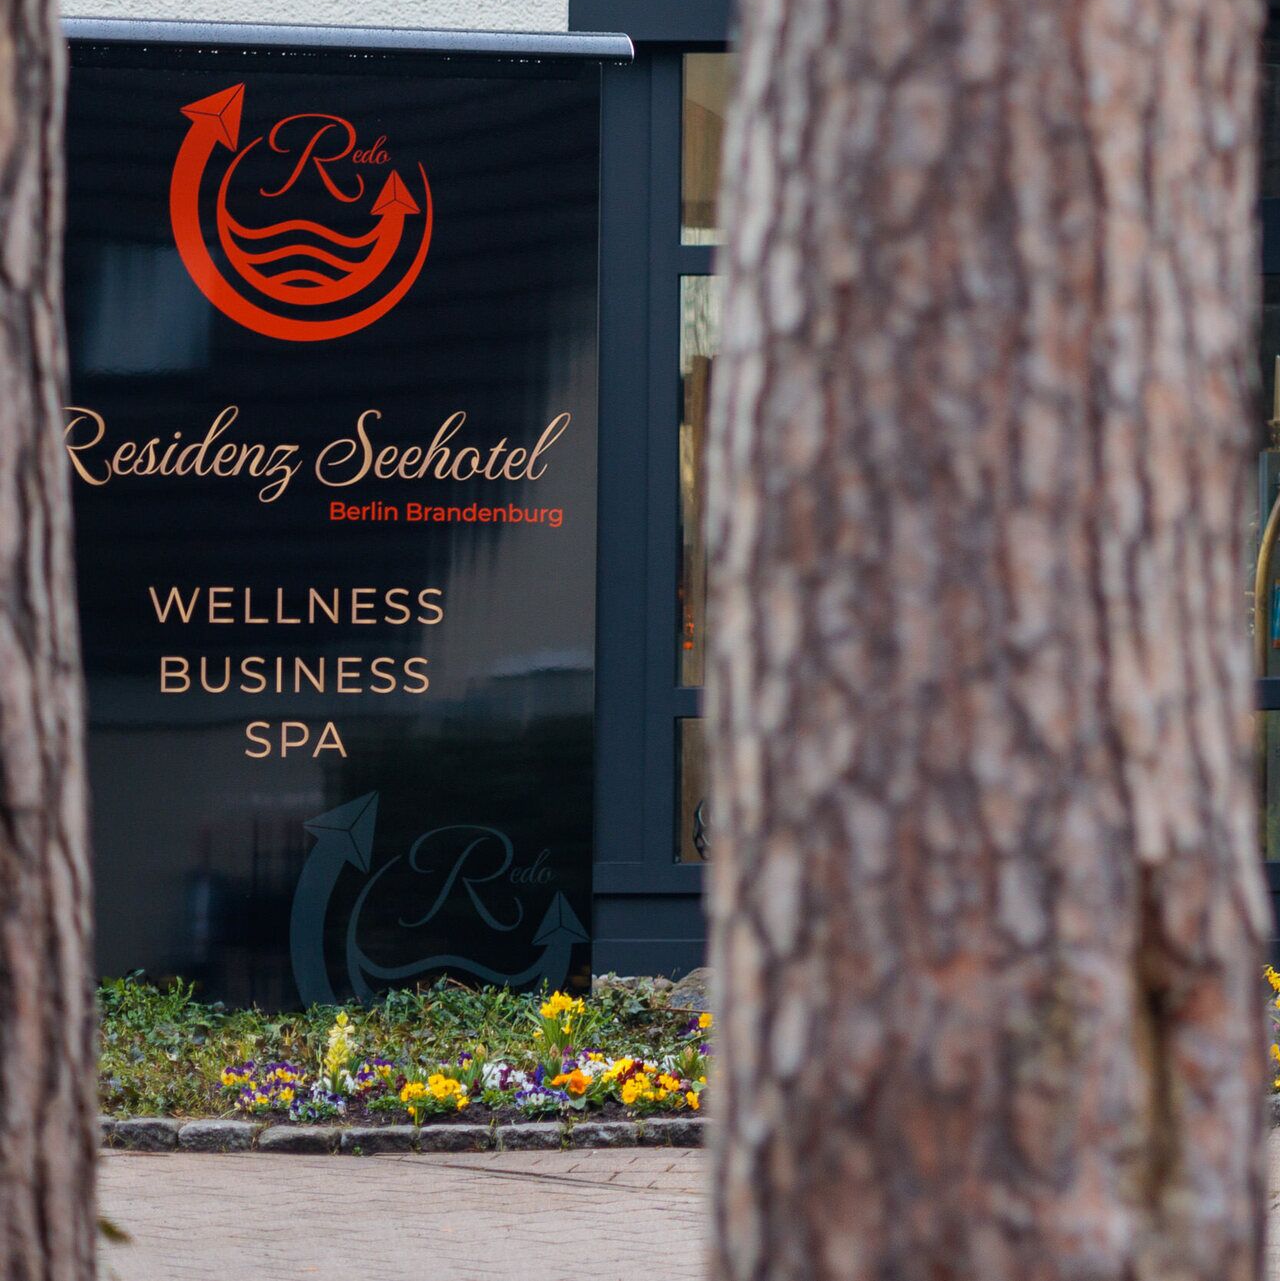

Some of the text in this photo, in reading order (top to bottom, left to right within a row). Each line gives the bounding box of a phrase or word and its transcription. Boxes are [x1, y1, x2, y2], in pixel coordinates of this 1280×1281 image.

[258, 113, 391, 203] Redo
[62, 405, 572, 503] Residenz Seehotel
[329, 500, 564, 528] Berlin Brandenburg
[148, 586, 444, 625] WELLNESS
[160, 656, 430, 694] BUSINESS
[244, 721, 348, 758] SPA
[398, 823, 554, 932] Redo
